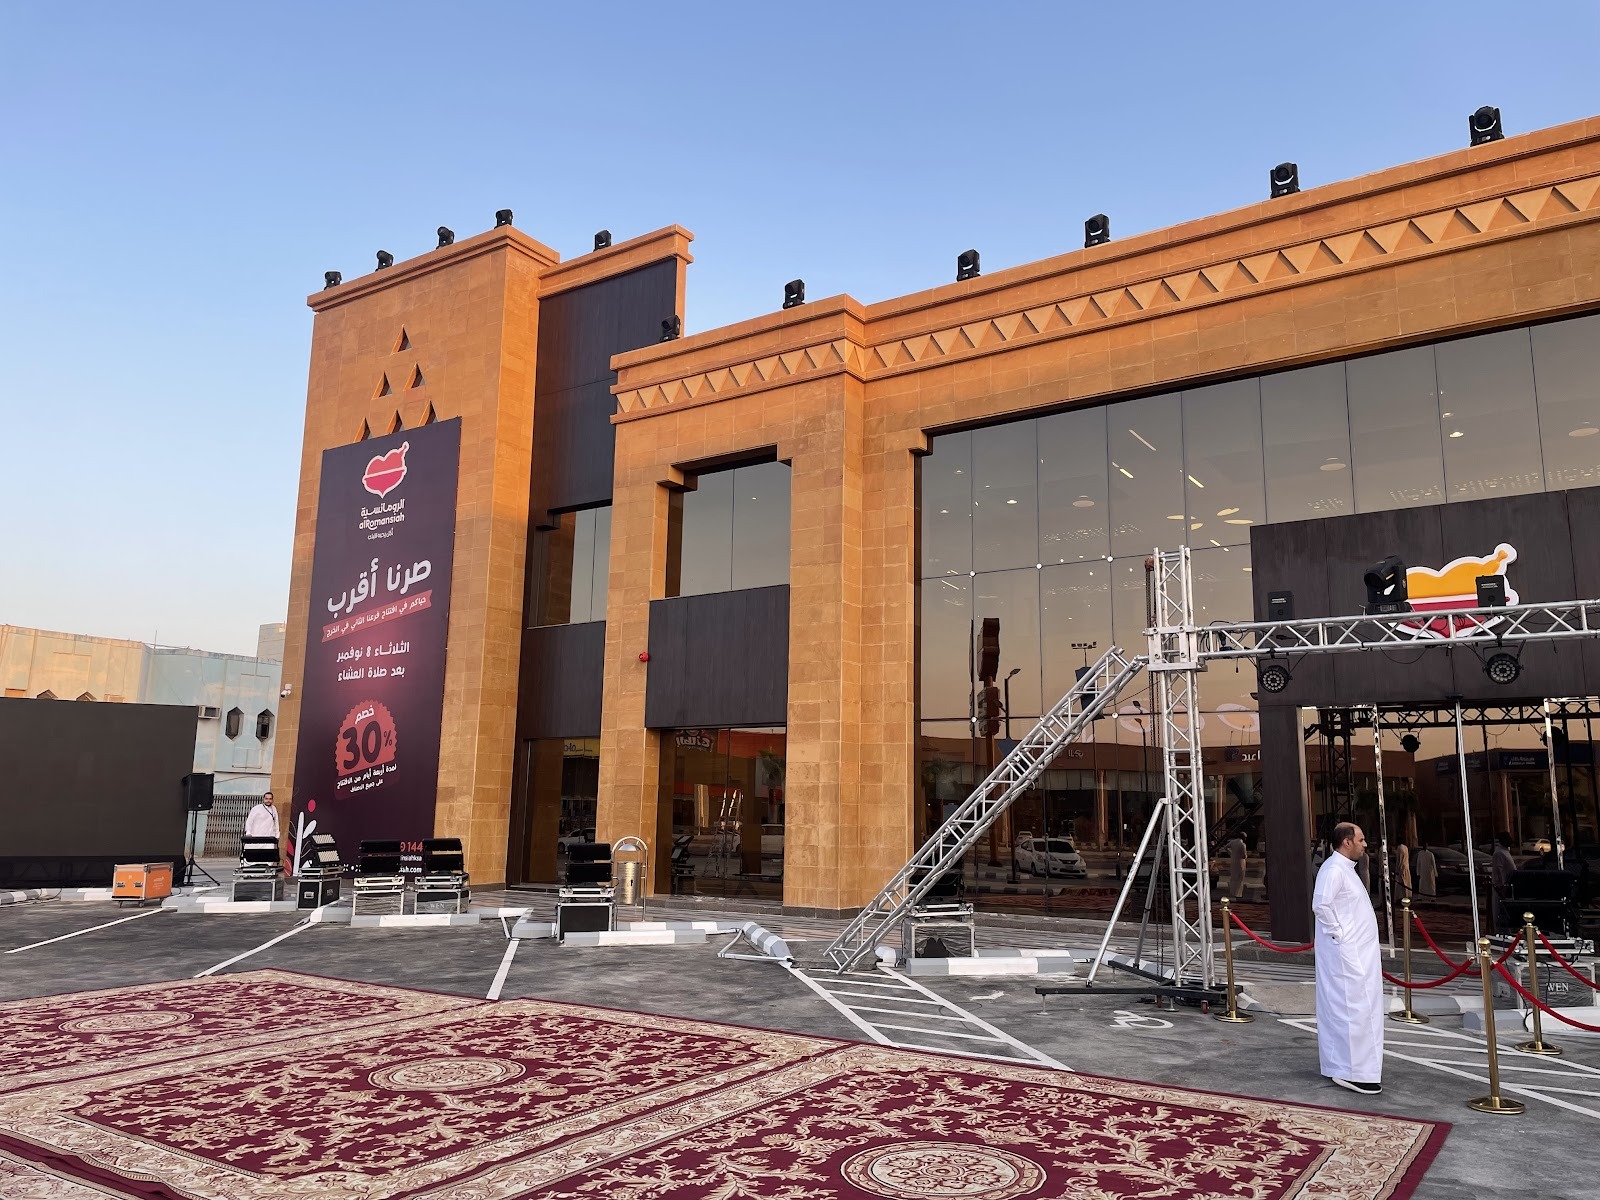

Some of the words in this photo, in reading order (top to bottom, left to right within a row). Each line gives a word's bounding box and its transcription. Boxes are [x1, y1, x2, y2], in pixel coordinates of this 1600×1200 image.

[360, 498, 405, 519] الرومانسية
[387, 559, 432, 595] صرنا
[327, 557, 379, 619] أقرب
[398, 602, 408, 615] في
[409, 596, 427, 610] حياكم
[366, 612, 380, 622] فرعنا
[326, 624, 340, 638] الخرج
[340, 621, 349, 635] في
[336, 646, 363, 663] نوفمبر
[366, 645, 371, 657] 8
[337, 666, 364, 682] العشاء
[367, 666, 387, 678] صلاة
[390, 665, 405, 678] بعد
[354, 704, 375, 725] خصم
